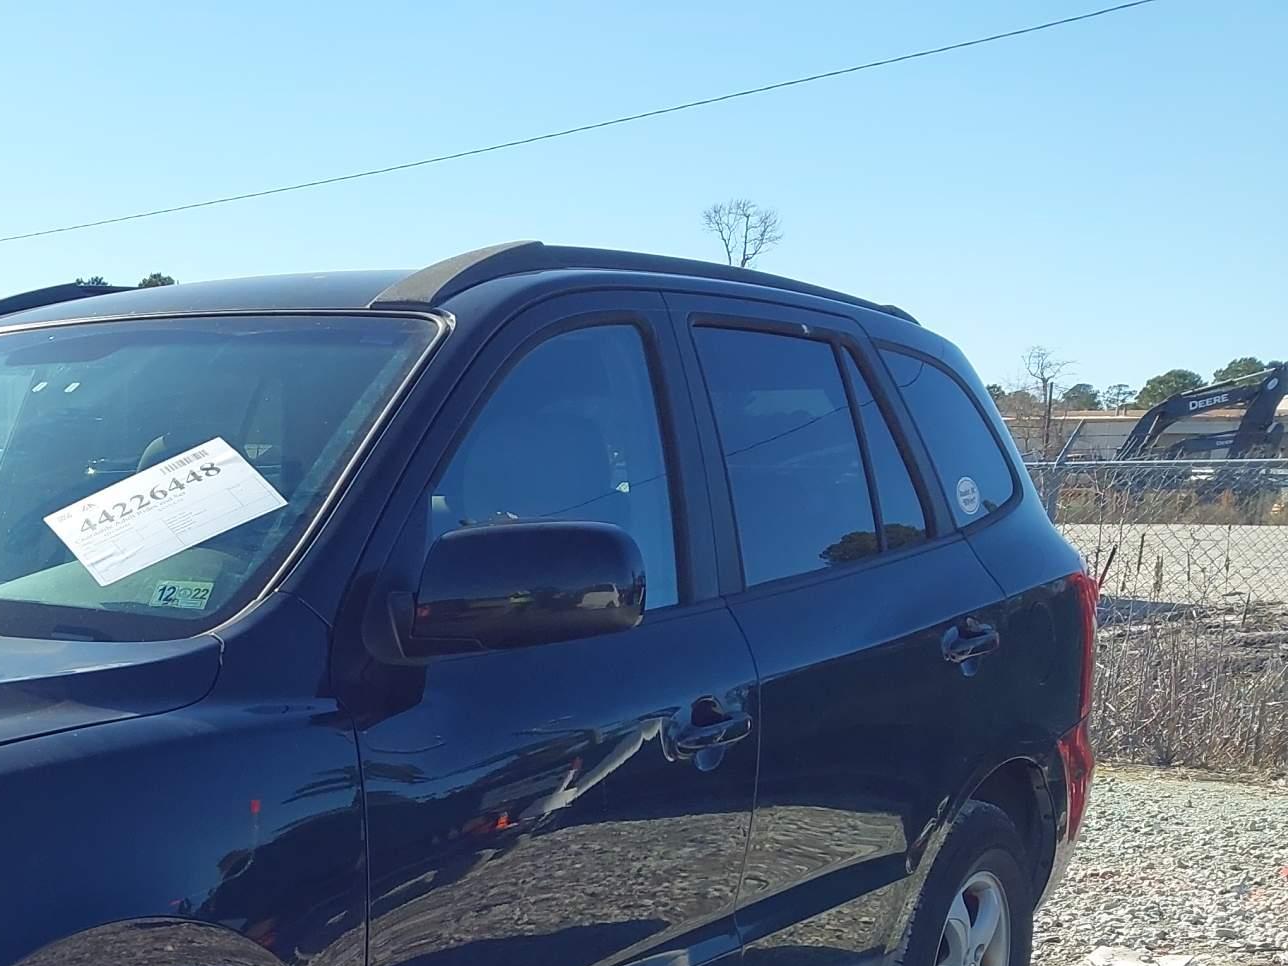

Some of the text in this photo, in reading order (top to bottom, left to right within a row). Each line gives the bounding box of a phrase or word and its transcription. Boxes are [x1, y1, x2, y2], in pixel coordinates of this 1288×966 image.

[1189, 393, 1230, 410] DEERE
[80, 462, 222, 533] 44226448
[158, 585, 210, 602] 12 22
